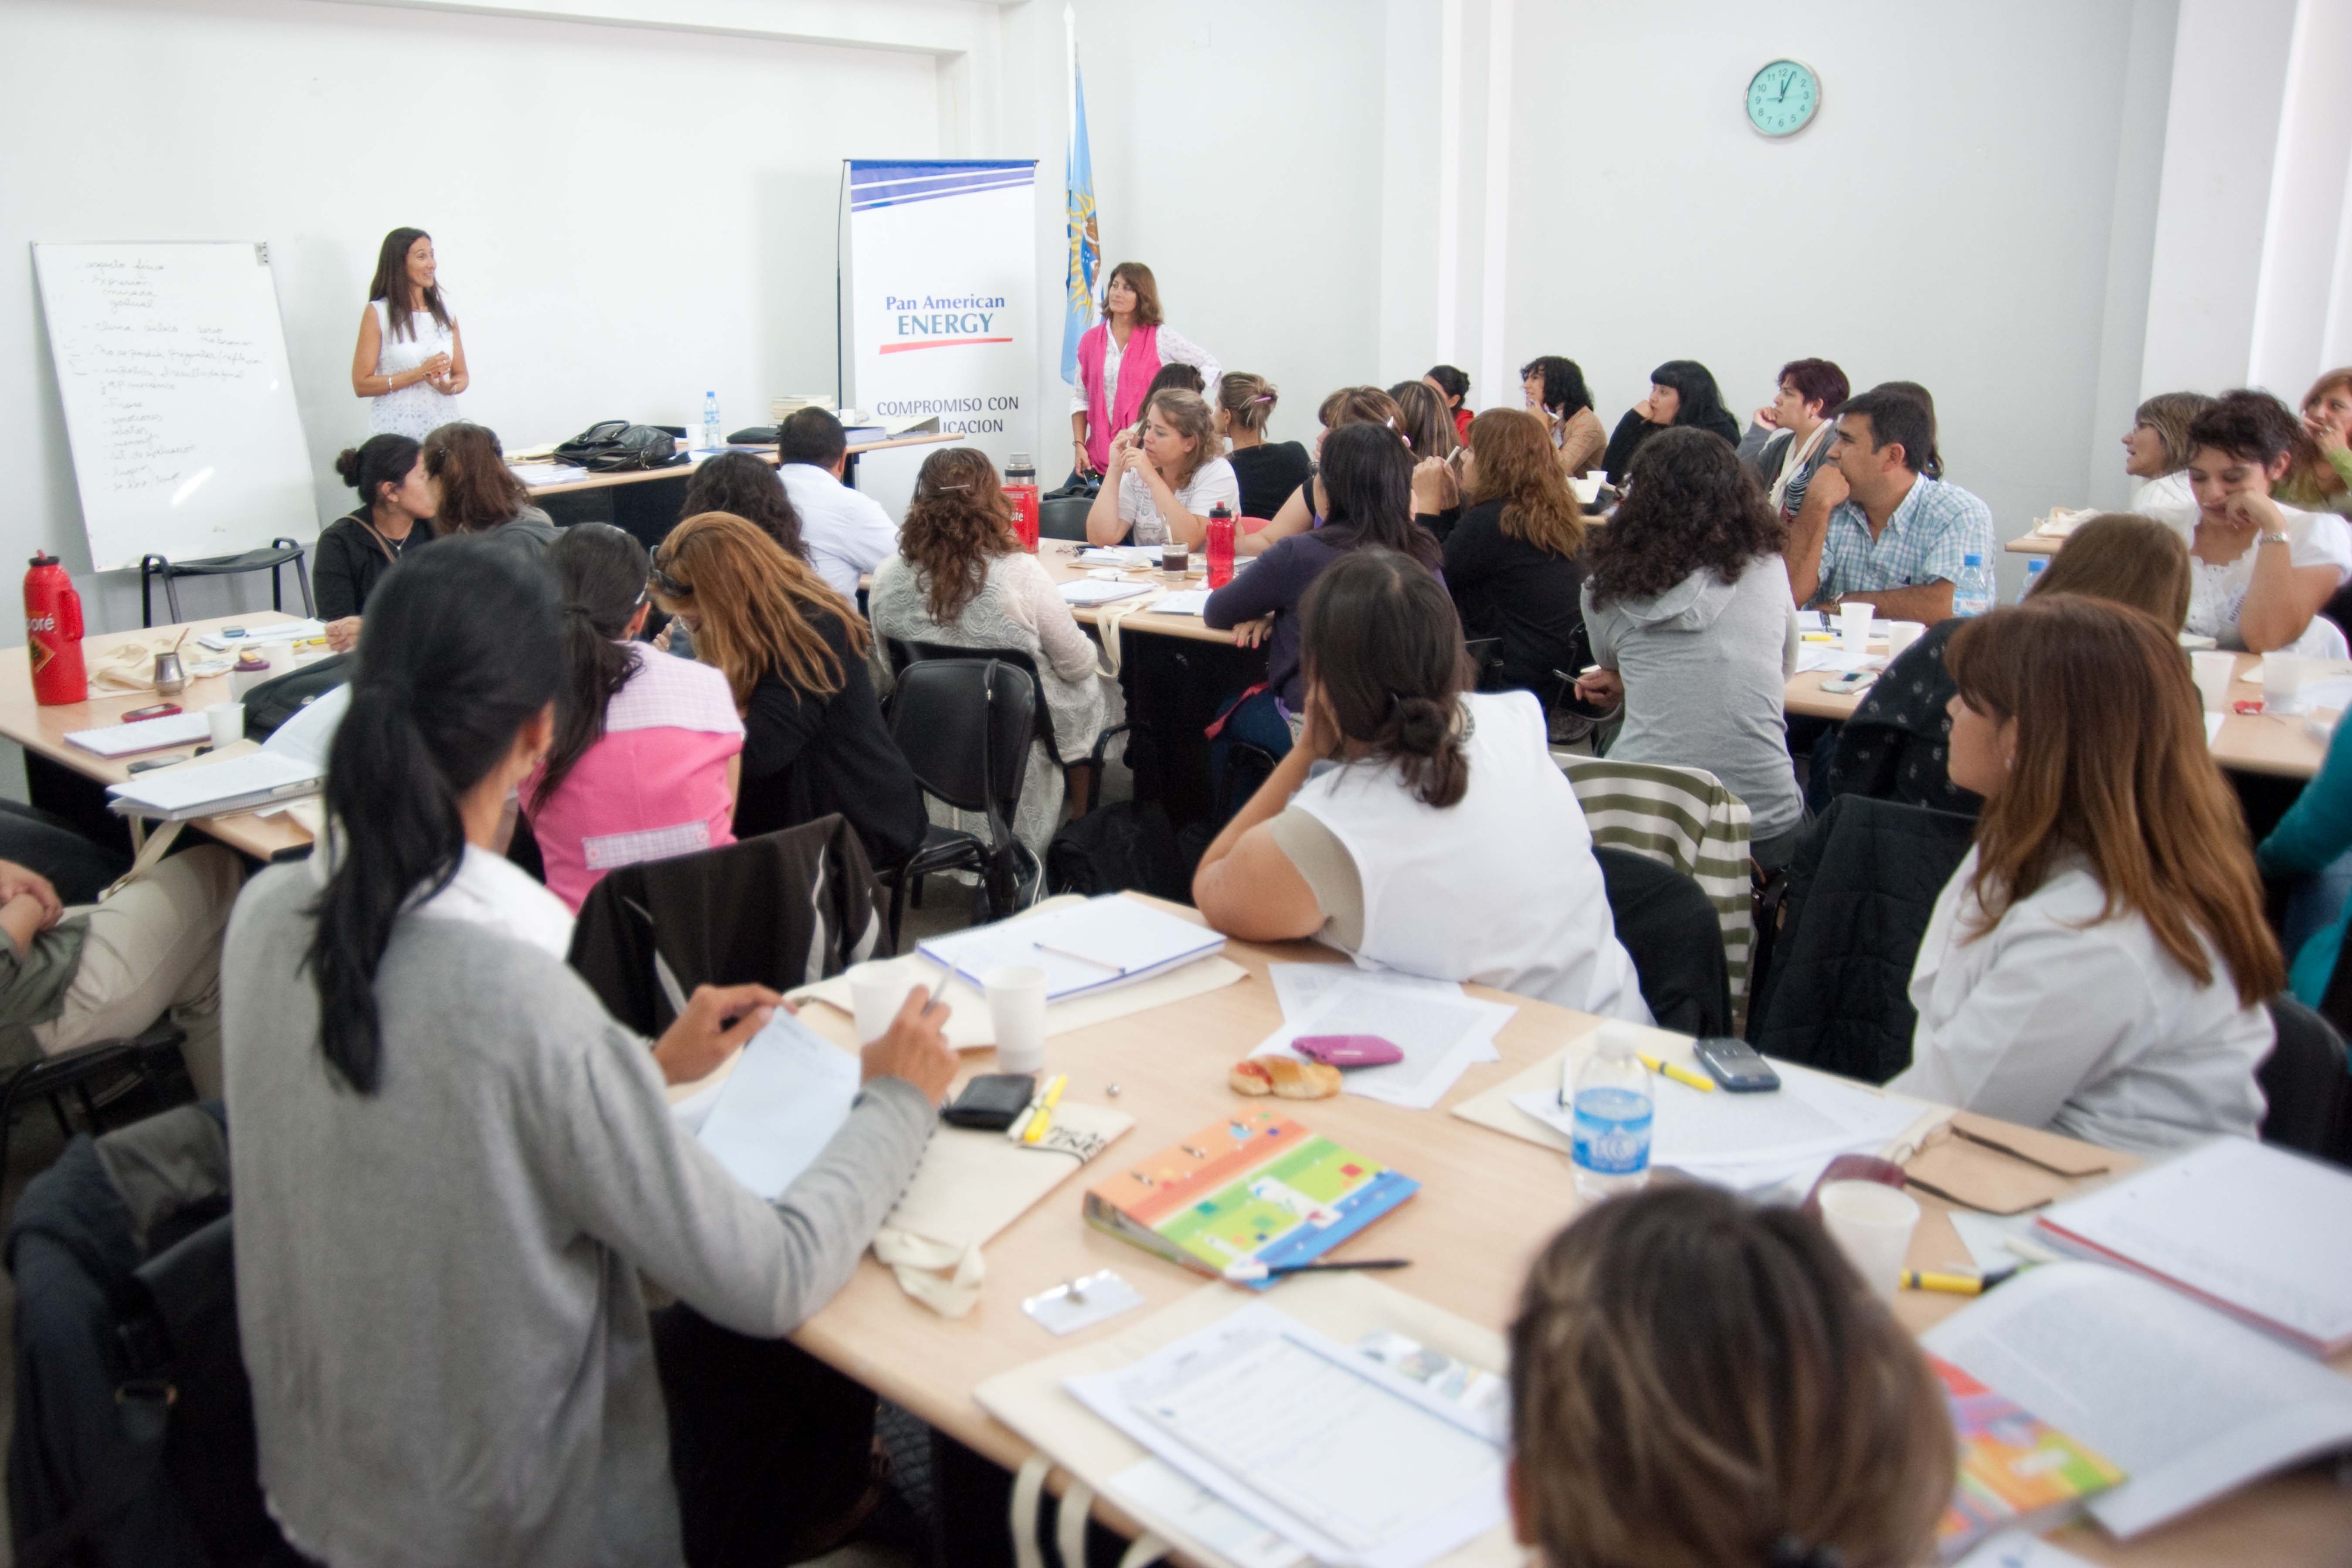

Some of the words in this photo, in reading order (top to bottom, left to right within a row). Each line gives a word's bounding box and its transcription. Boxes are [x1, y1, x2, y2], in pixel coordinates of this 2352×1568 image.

[1778, 68, 1788, 76] 12
[1801, 79, 1807, 87] 2
[1757, 84, 1766, 92] 10
[1803, 91, 1809, 99] 3
[1755, 96, 1761, 104] 9
[1758, 108, 1764, 116] 8
[1767, 116, 1772, 125] 7
[1778, 119, 1784, 127] 6
[886, 295, 916, 310] Pan
[923, 294, 1005, 310] American
[897, 313, 994, 336] ENERGY
[877, 397, 982, 416] COMPROMISO
[988, 396, 1019, 411] CON
